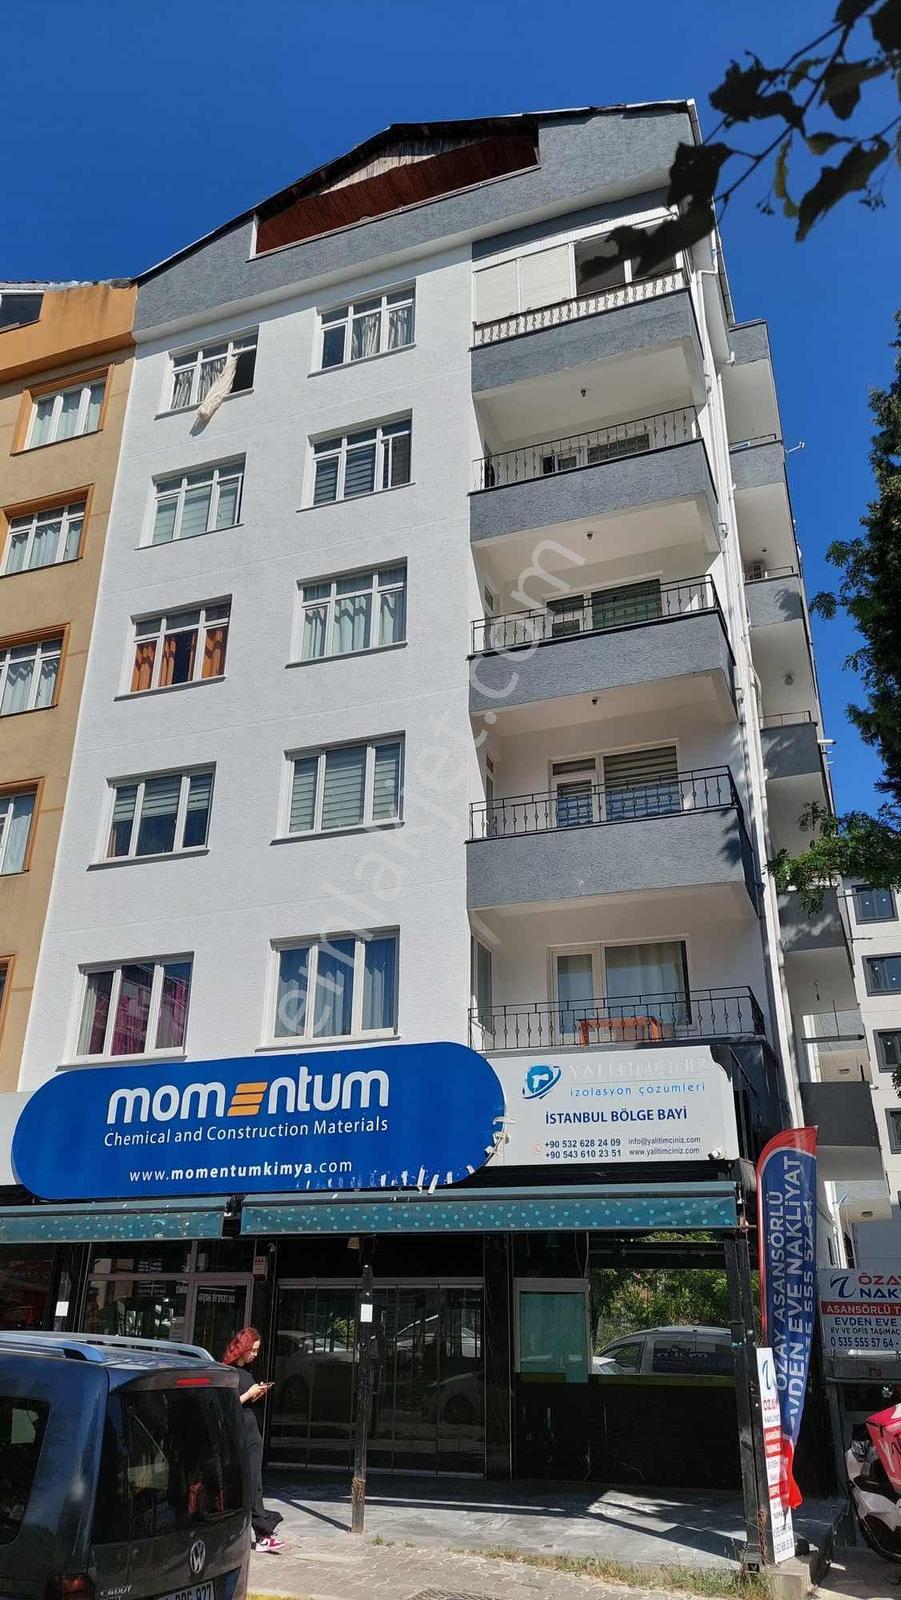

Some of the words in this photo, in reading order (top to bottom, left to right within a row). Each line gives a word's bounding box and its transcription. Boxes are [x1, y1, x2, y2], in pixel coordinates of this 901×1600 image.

[106, 1066, 391, 1125] momentum
[545, 1111, 608, 1124] İSTANBUL
[611, 1108, 654, 1122] BÖLGE
[657, 1105, 688, 1120] BAYİ
[103, 1127, 171, 1148] Chemical
[174, 1126, 203, 1143] and
[206, 1121, 309, 1142] Construction
[313, 1115, 389, 1136] Materials
[545, 1140, 560, 1148] +90
[562, 1139, 578, 1148] 532
[579, 1139, 595, 1147] 628
[597, 1138, 608, 1147] 24
[610, 1138, 621, 1146] 09
[545, 1150, 560, 1159] +90
[563, 1150, 578, 1158] 543
[580, 1150, 596, 1158] 610
[598, 1149, 609, 1157] 23
[611, 1149, 622, 1157] 51
[129, 1159, 353, 1183] www.momentumkimya.com
[766, 1191, 786, 1323] ASANSÖRLÜ
[803, 1270, 814, 1312] 555
[786, 1284, 803, 1333] EVE
[826, 1303, 891, 1314] ASANSÖRLÜ
[835, 1317, 872, 1326] EVDEN
[876, 1318, 898, 1327] EVE
[838, 1336, 853, 1347] 535
[855, 1337, 869, 1347] 555
[871, 1337, 881, 1348] 57
[883, 1337, 894, 1348] 64
